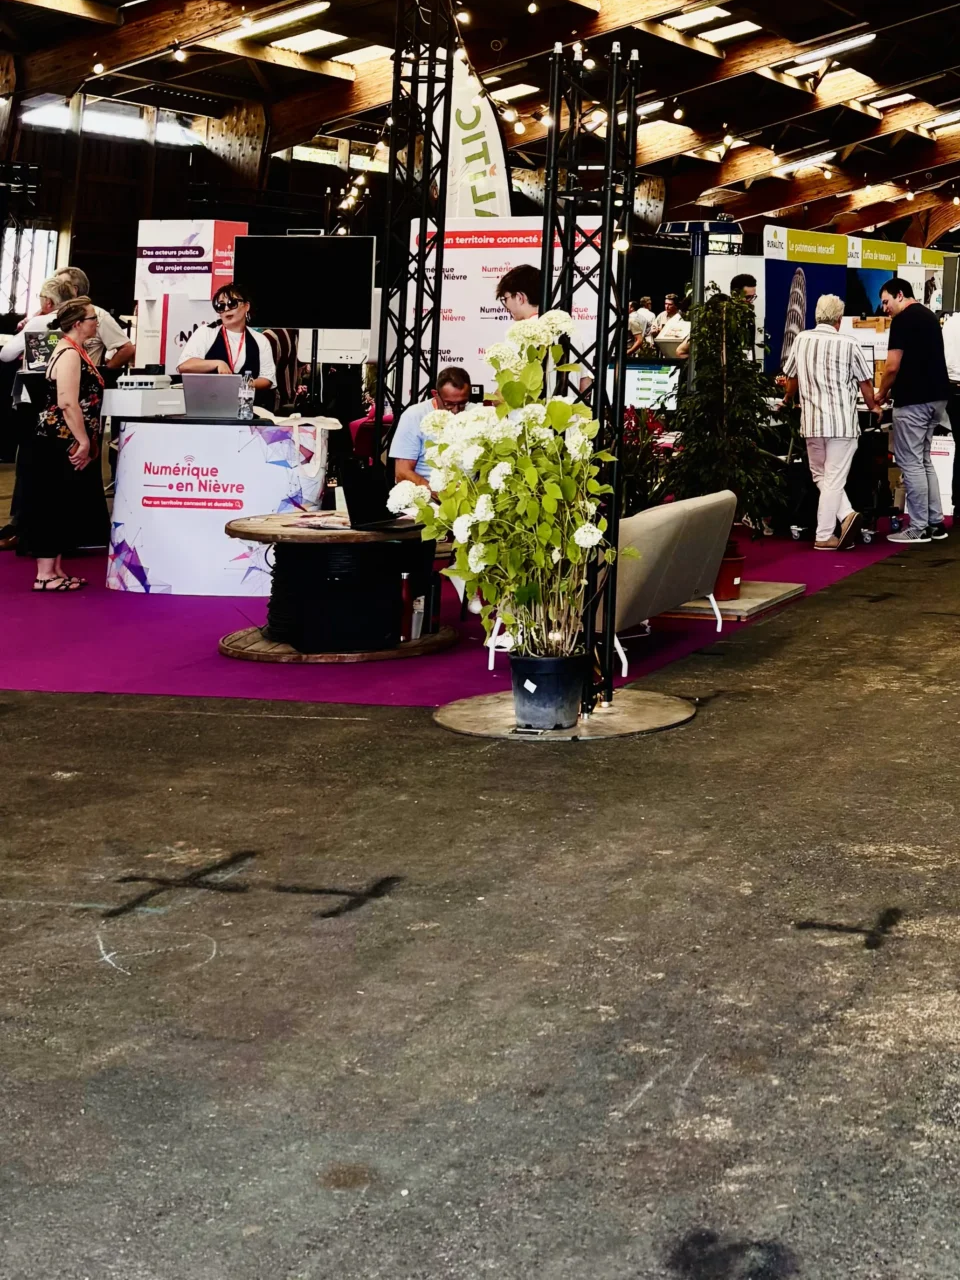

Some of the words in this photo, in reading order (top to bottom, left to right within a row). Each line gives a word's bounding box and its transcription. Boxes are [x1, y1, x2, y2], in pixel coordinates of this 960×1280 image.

[455, 235, 495, 244] territoire
[496, 235, 538, 244] connecté
[788, 239, 795, 251] Le
[795, 242, 817, 254] patrimoine
[817, 244, 835, 255] interactif
[177, 249, 200, 257] publics
[443, 273, 467, 281] Nièvre
[440, 355, 464, 363] Nièvre
[143, 461, 219, 480] Numérique
[175, 481, 194, 492] en
[198, 480, 245, 494] Nièvre
